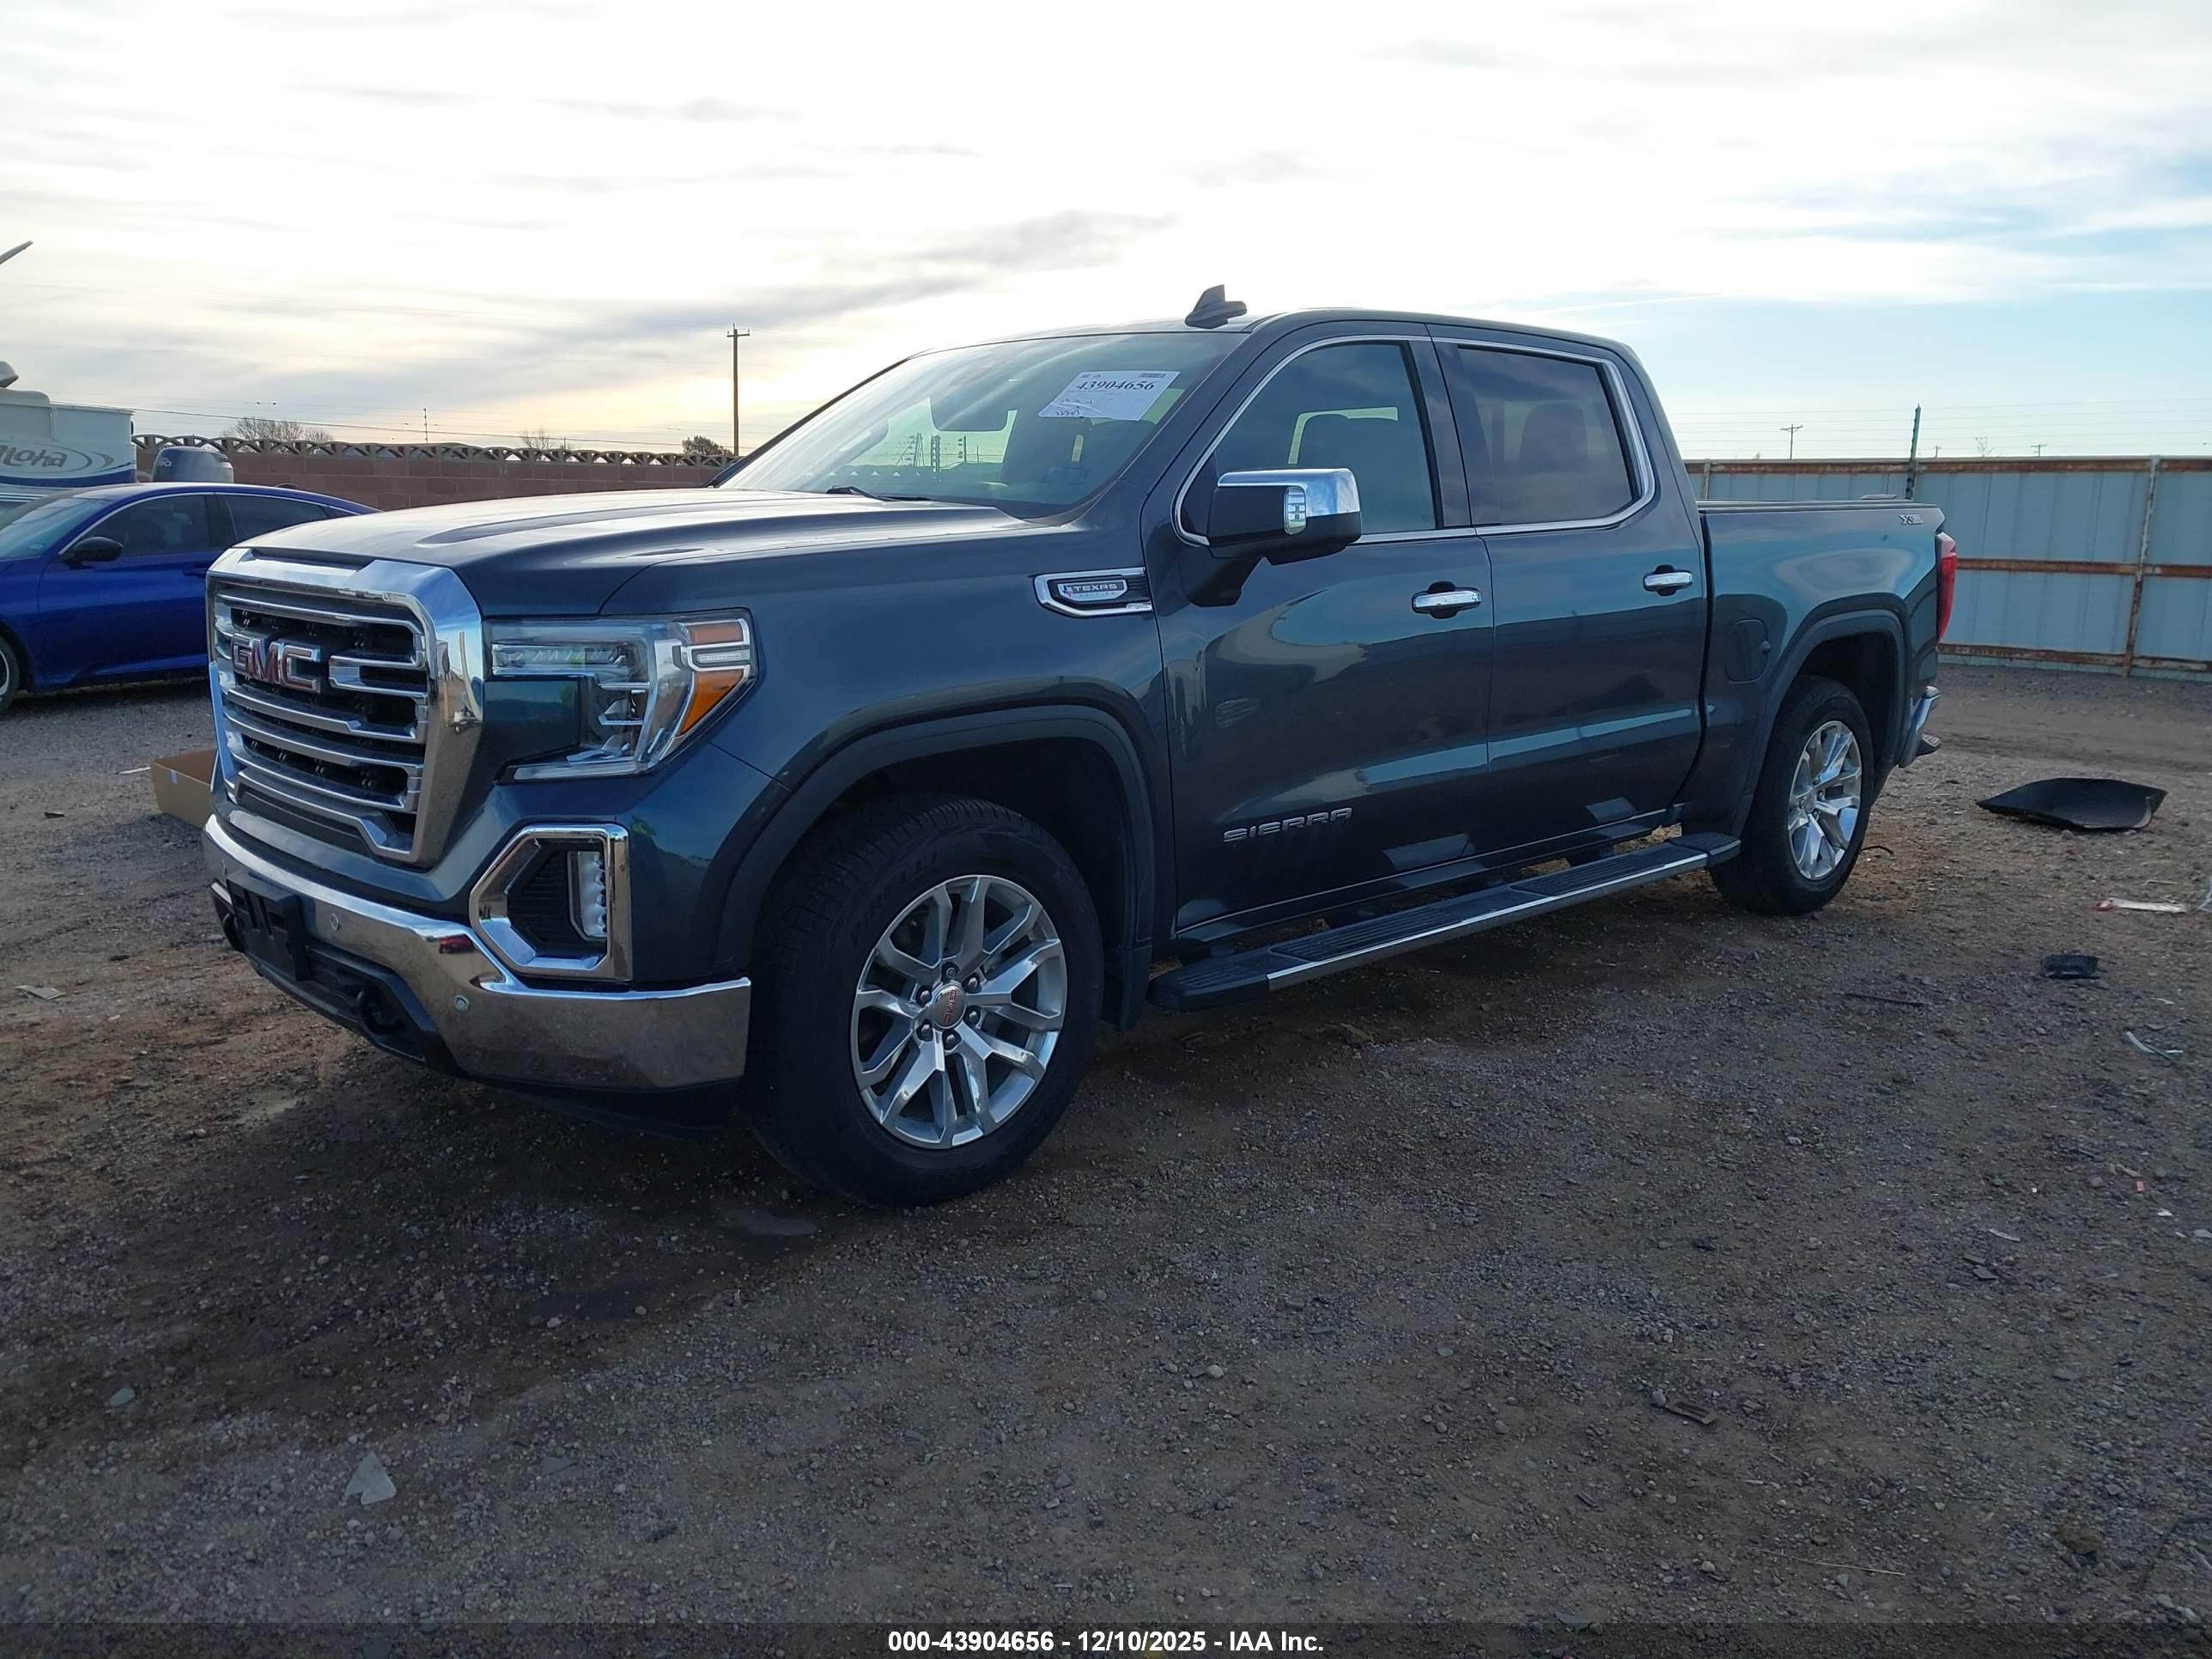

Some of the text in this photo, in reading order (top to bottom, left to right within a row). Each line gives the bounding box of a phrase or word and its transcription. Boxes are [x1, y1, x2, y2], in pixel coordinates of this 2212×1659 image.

[1076, 380, 1159, 391] 43904656
[1073, 583, 1118, 592] TEXAS
[231, 633, 320, 694] GMC
[1223, 807, 1352, 842] SIERRA
[943, 988, 957, 1024] GMC
